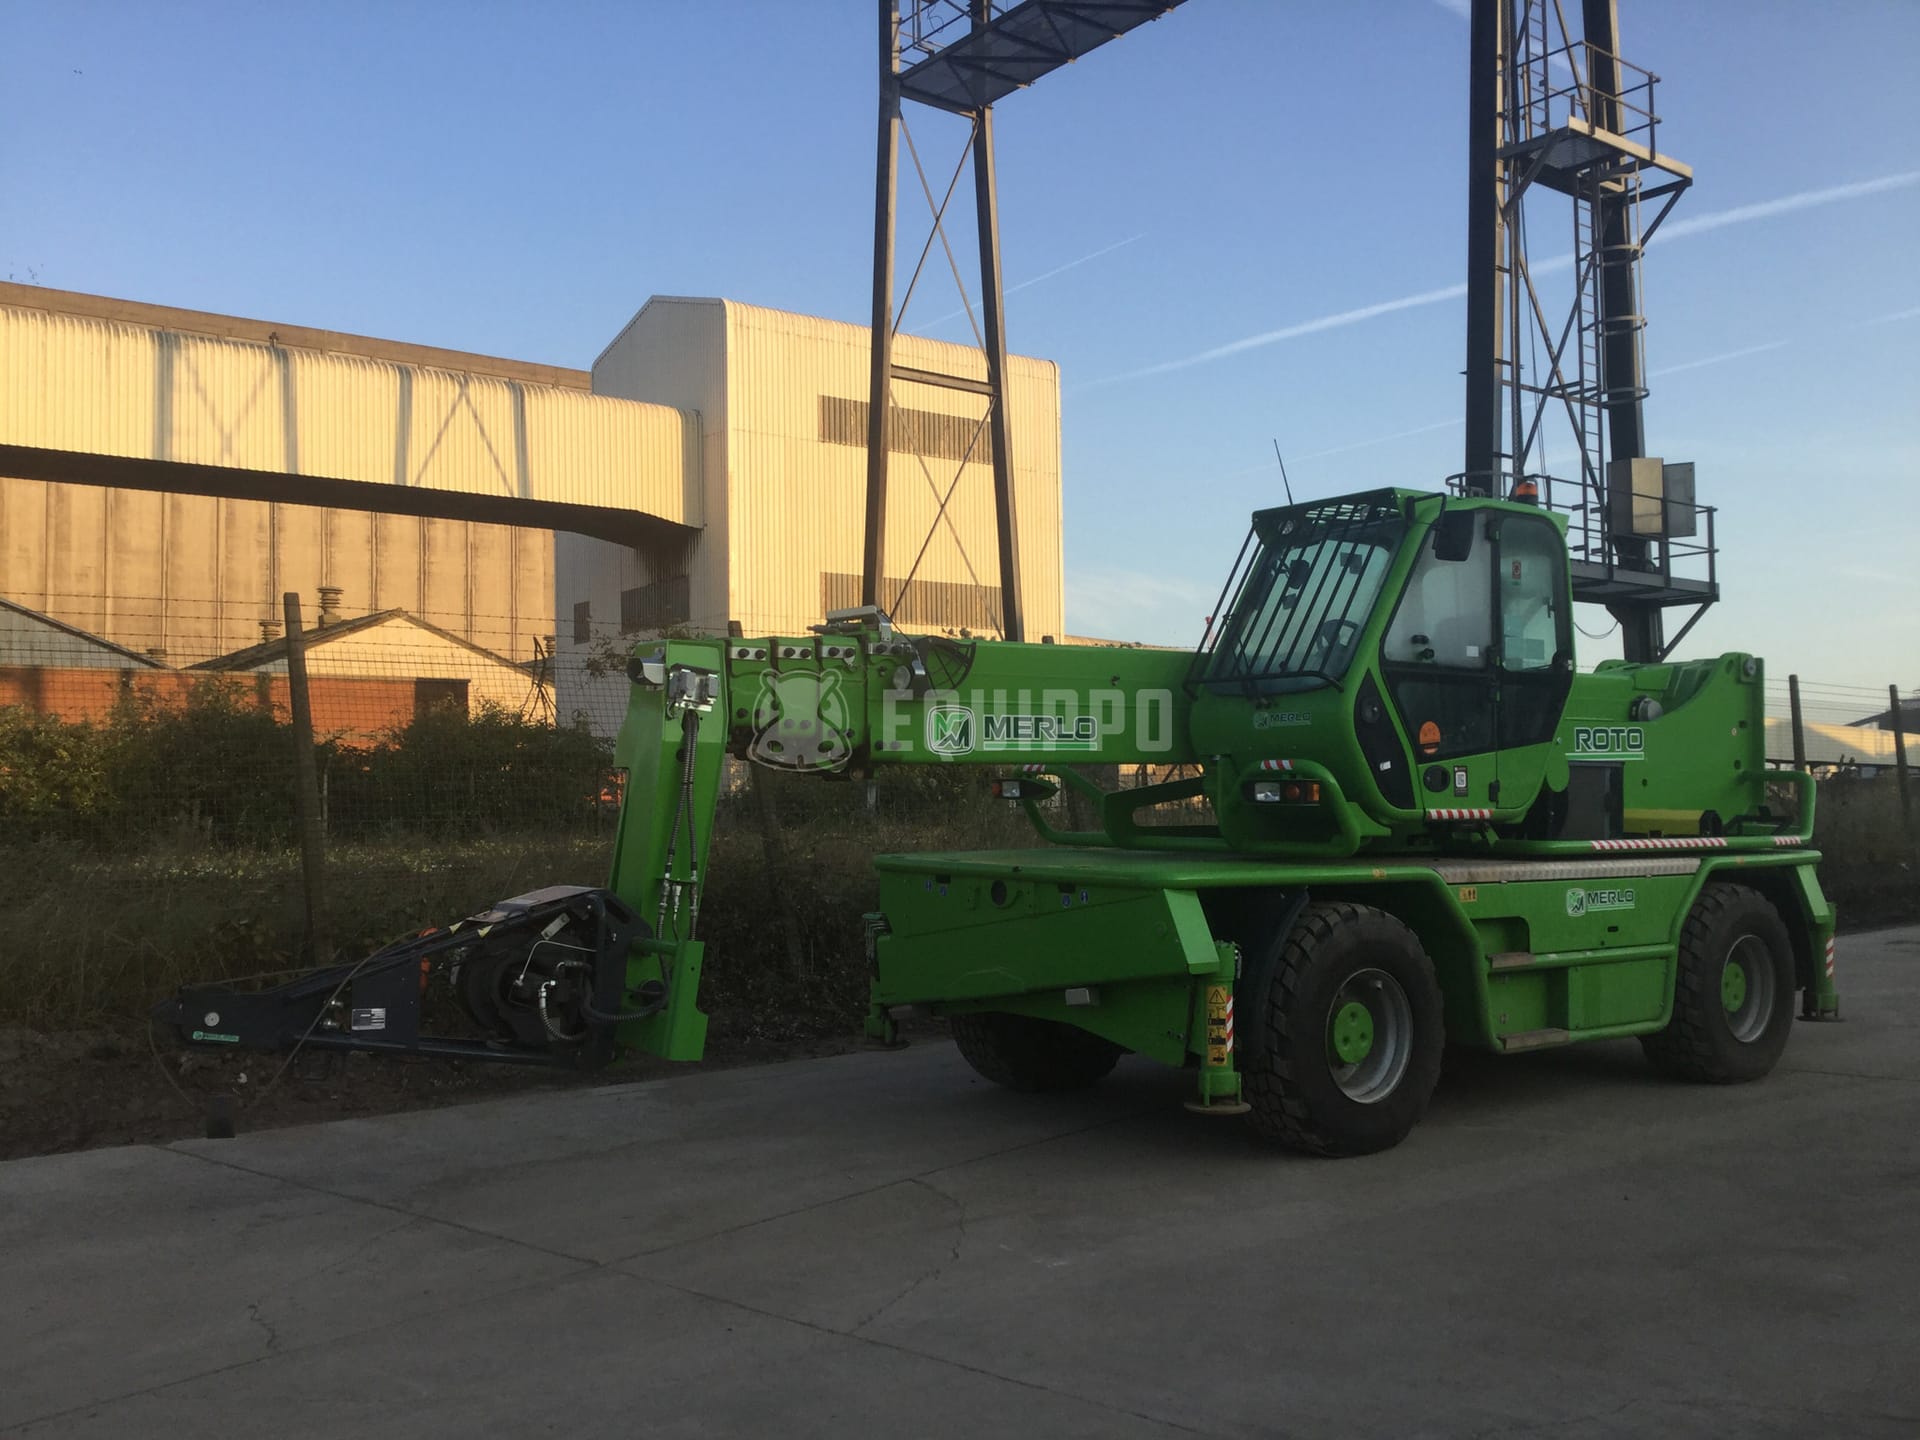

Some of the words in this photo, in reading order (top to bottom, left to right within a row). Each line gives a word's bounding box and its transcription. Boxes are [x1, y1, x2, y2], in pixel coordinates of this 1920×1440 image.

[1270, 712, 1312, 723] MERLO
[983, 714, 1097, 742] MERLO
[1574, 727, 1644, 752] ROTO
[1587, 889, 1635, 905] MERLO
